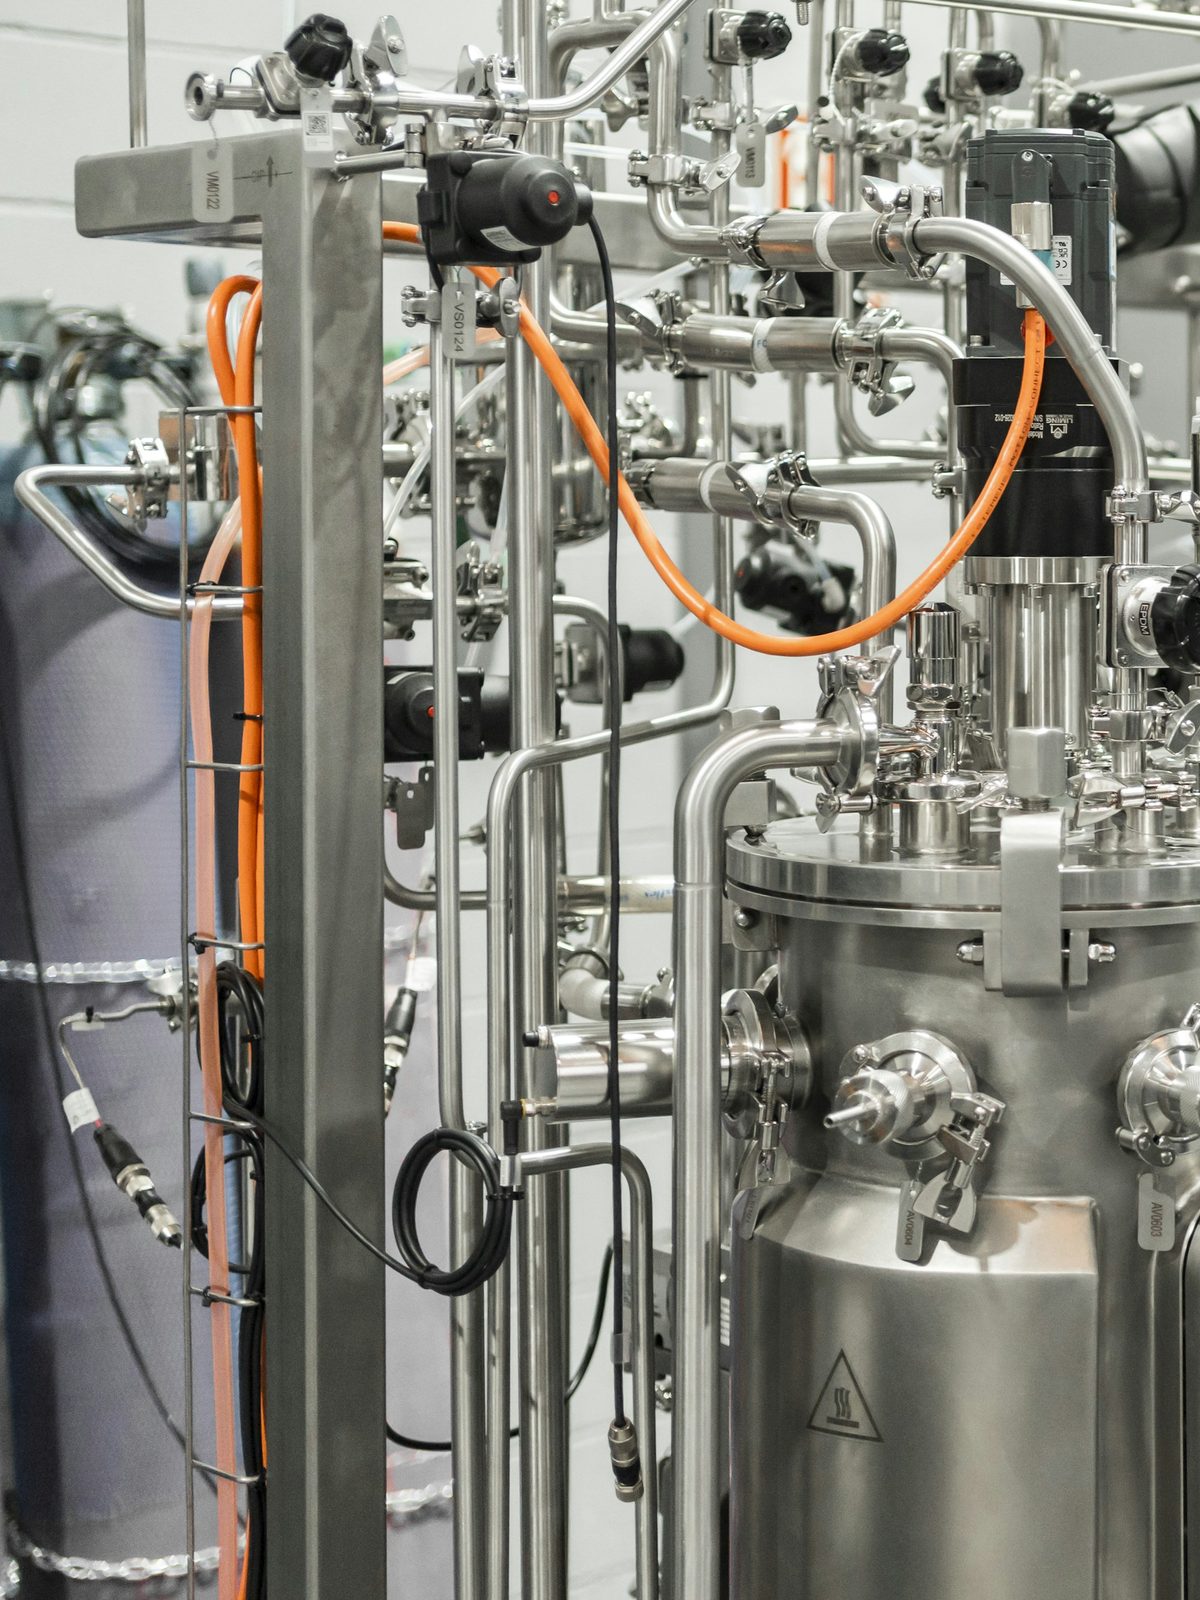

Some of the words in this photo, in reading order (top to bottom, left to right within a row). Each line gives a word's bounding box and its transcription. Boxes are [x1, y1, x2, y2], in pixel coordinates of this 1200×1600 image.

[206, 171, 220, 210] VM0122
[454, 302, 465, 353] VS0124
[1140, 604, 1149, 635] EPDM
[904, 1210, 915, 1246] AV0604
[1151, 1202, 1163, 1237] AV0603
